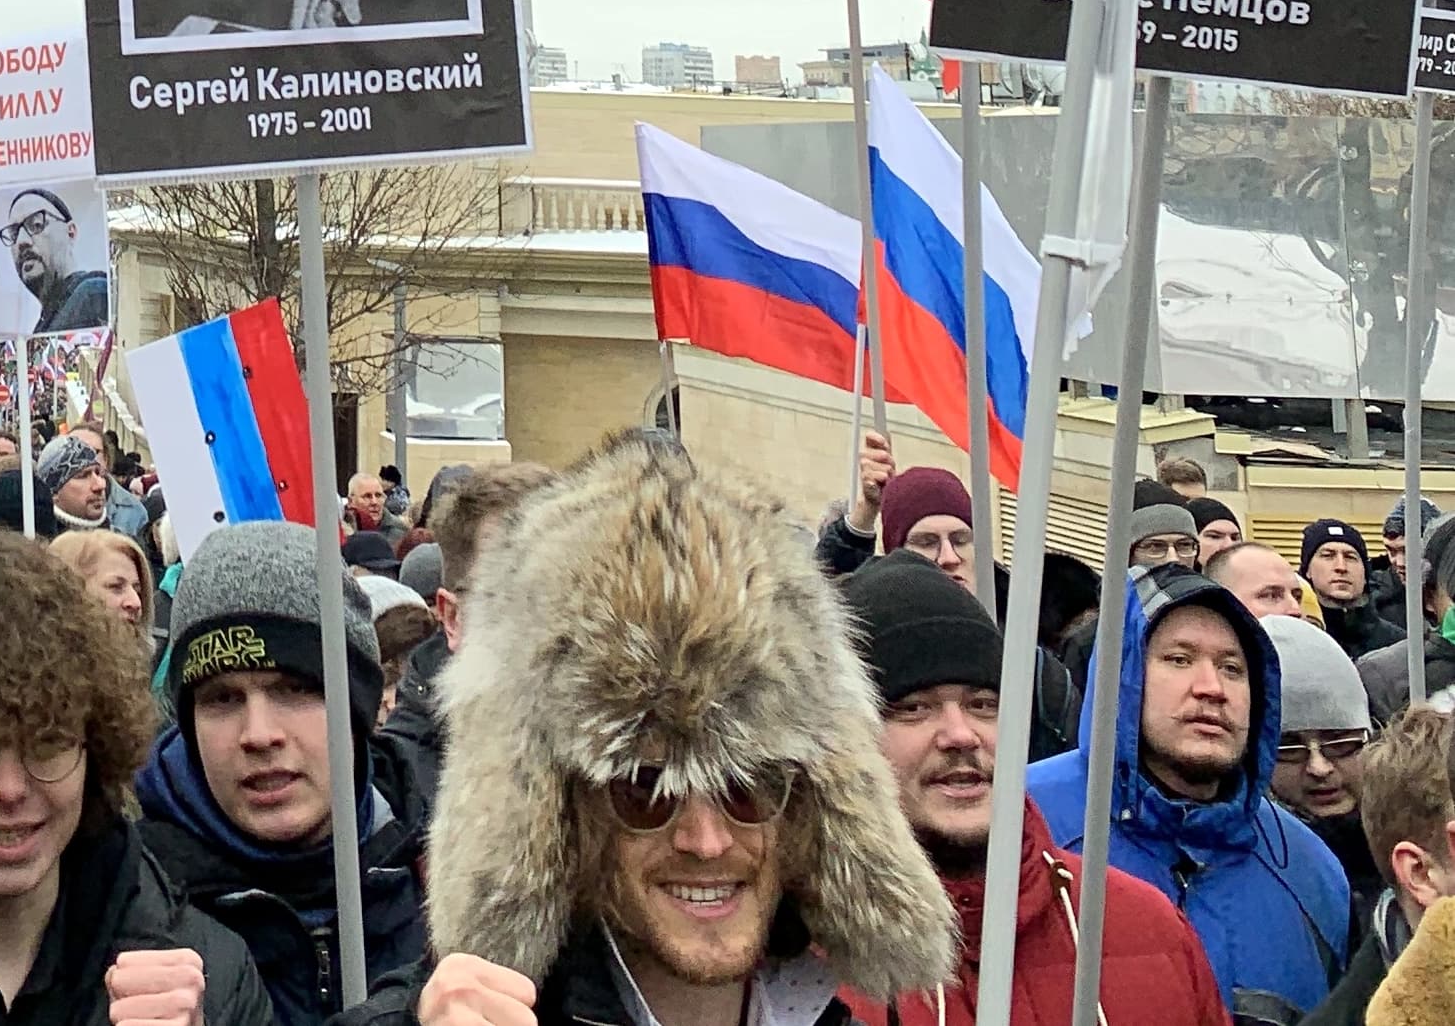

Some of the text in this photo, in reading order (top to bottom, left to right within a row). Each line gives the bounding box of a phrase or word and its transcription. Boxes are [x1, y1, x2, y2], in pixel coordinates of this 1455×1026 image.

[1182, 25, 1239, 52] 2015
[129, 52, 483, 116] Сергей Калиновский
[247, 110, 298, 138] 1975
[320, 106, 372, 134] 2001
